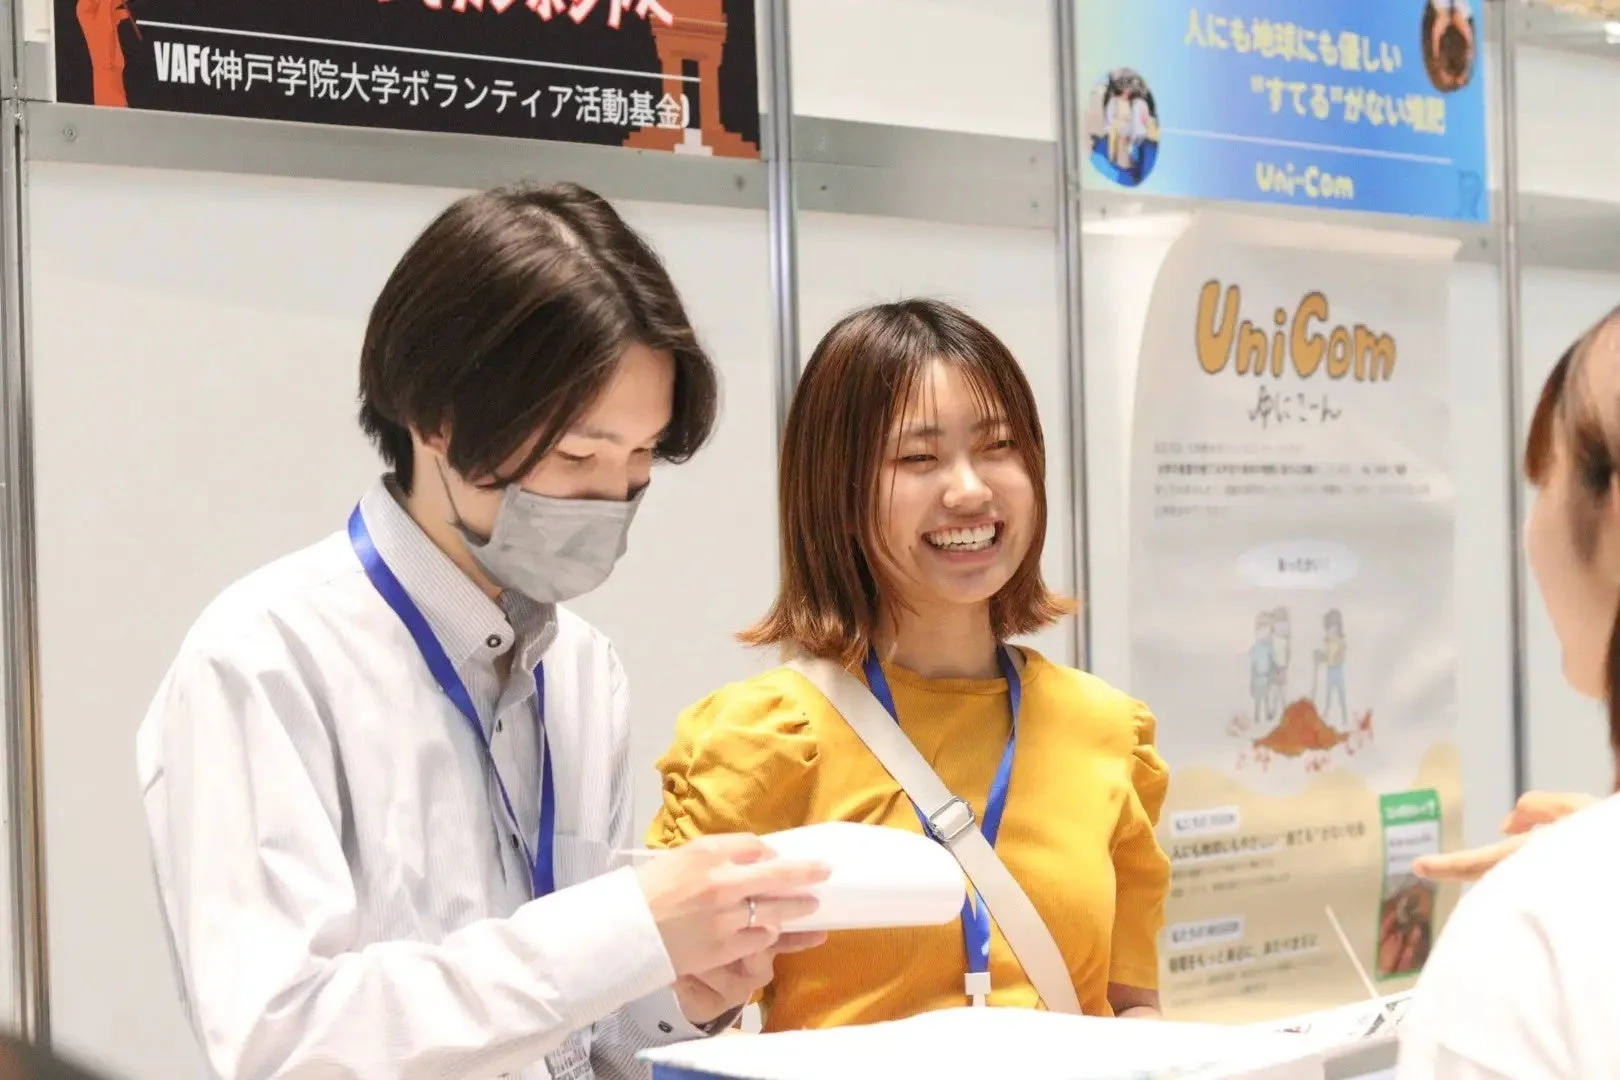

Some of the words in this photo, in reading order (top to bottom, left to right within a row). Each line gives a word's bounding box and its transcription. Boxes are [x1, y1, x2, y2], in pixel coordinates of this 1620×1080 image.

[1184, 10, 1402, 73] 人にも地球にも優しい
[153, 41, 690, 129] VAF(神戸学院大学ボランティア活動基金)
[1256, 162, 1355, 200] Uni-Com
[1195, 278, 1397, 382] UniCom
